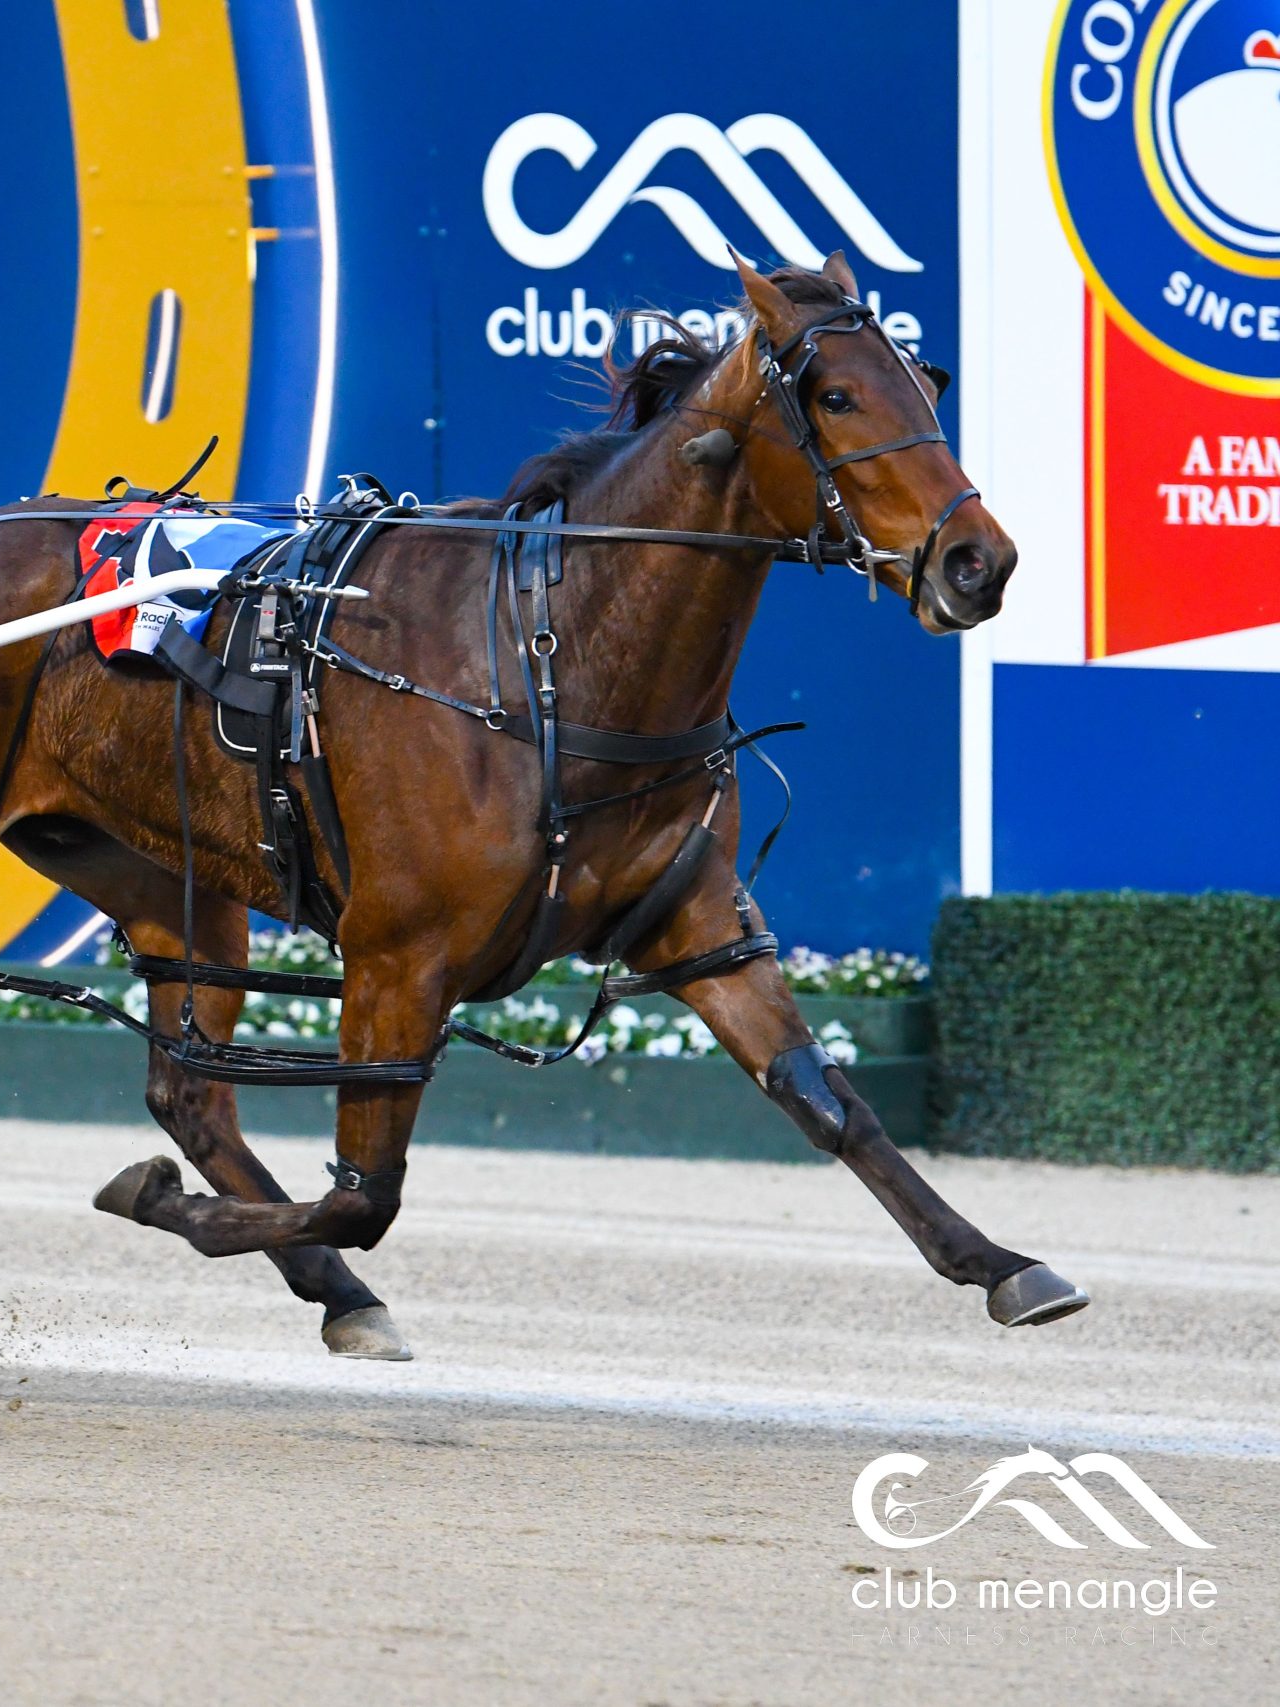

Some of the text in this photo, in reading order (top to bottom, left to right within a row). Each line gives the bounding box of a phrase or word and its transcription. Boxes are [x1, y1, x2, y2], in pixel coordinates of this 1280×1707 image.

[1071, 0, 1150, 121] CO
[486, 287, 923, 362] club menle
[1162, 270, 1280, 341] SINCE
[1182, 435, 1214, 476] A
